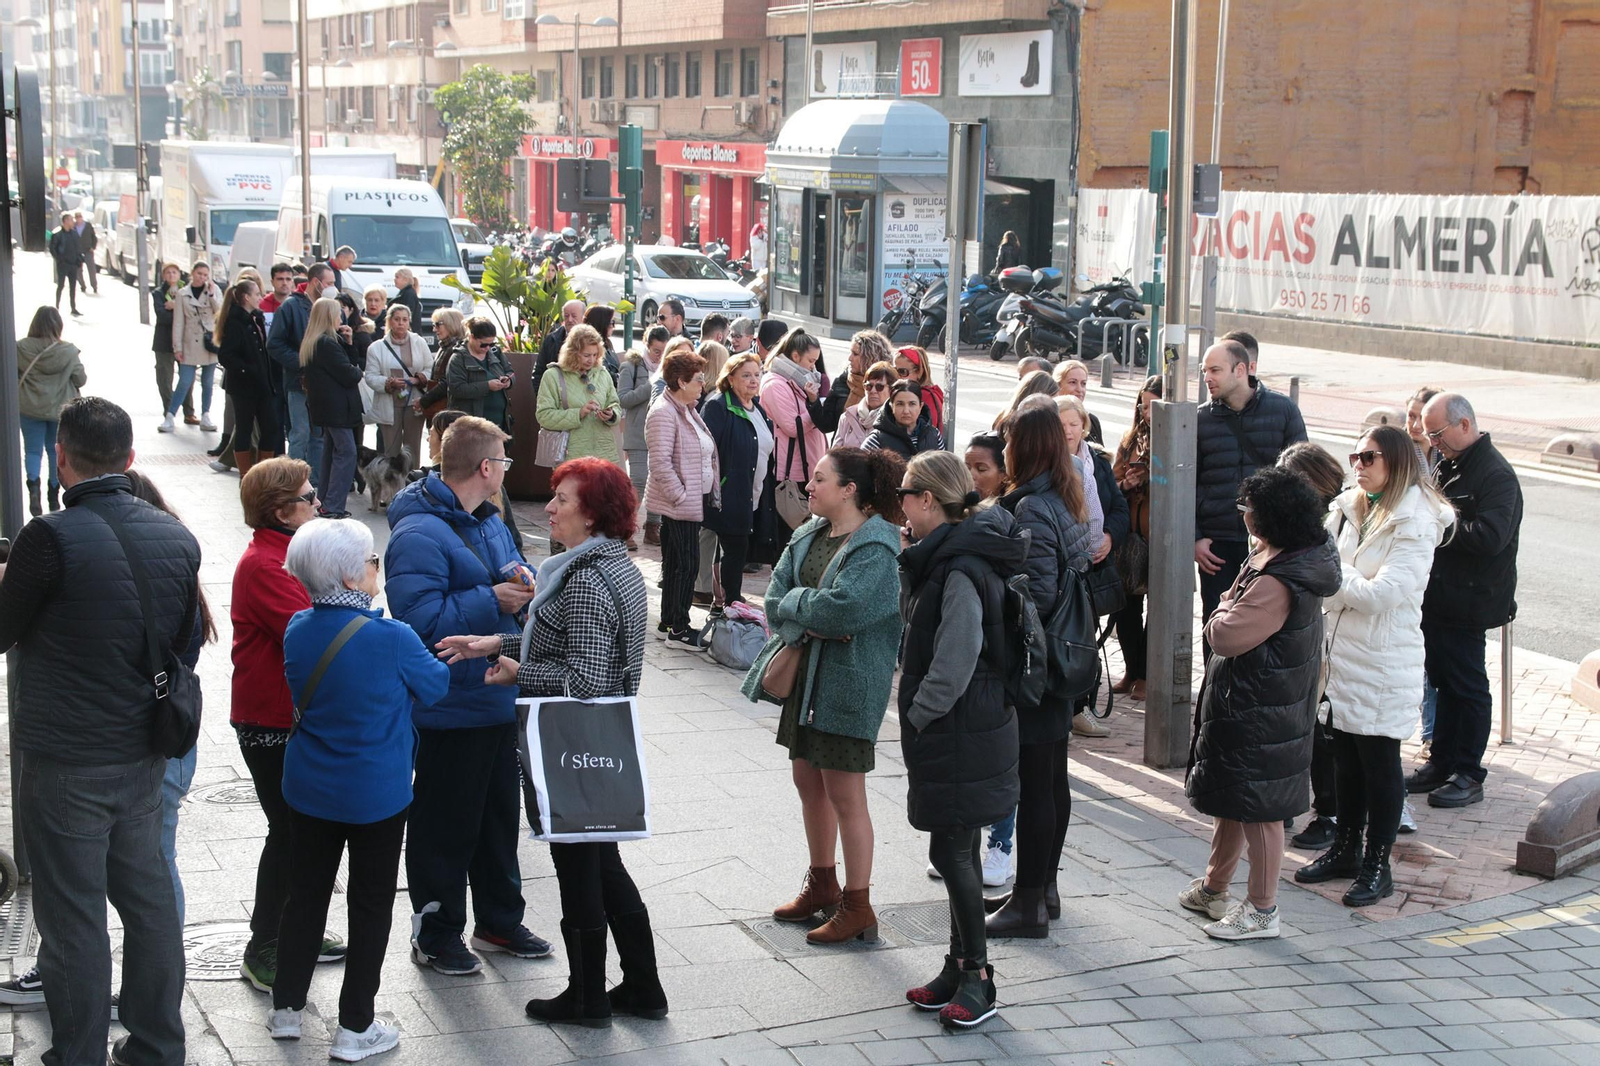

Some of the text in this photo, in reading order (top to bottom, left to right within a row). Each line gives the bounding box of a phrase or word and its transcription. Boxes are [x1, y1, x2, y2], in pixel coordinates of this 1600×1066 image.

[682, 142, 737, 164] deportes Blanes
[239, 182, 272, 190] PVC
[345, 192, 428, 202] PLASTICOS
[913, 198, 946, 206] DUPLICAD
[888, 224, 919, 232] AFILADO
[1330, 200, 1554, 278] ALMERÍA
[1285, 270, 1310, 280] GRACIAS
[1319, 273, 1338, 282] QUIEN
[1361, 276, 1390, 286] GRACIAS
[1392, 278, 1441, 289] INSTITUCIONES
[1449, 282, 1487, 291] EMPRESAS
[1280, 288, 1371, 315] 950 25 71 66
